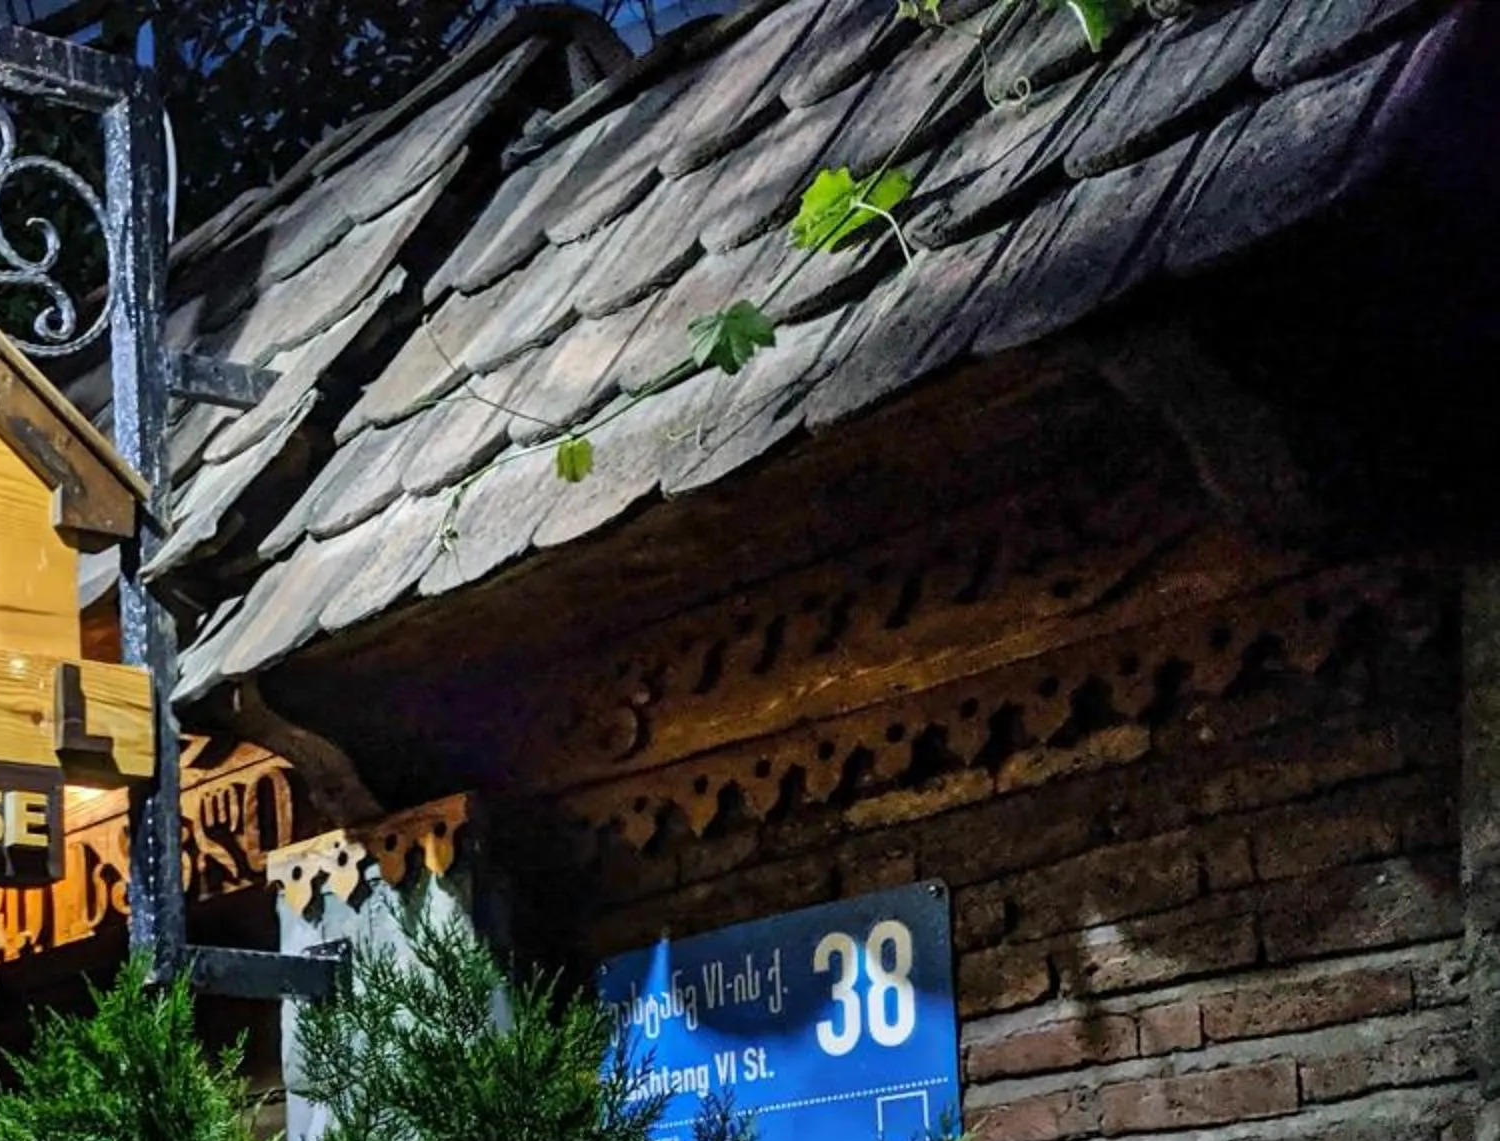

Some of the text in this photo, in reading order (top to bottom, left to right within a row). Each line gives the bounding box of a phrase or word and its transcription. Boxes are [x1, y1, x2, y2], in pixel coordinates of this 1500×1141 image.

[812, 919, 917, 1057] 38
[713, 1050, 737, 1085] VI
[743, 1045, 776, 1082] St.
